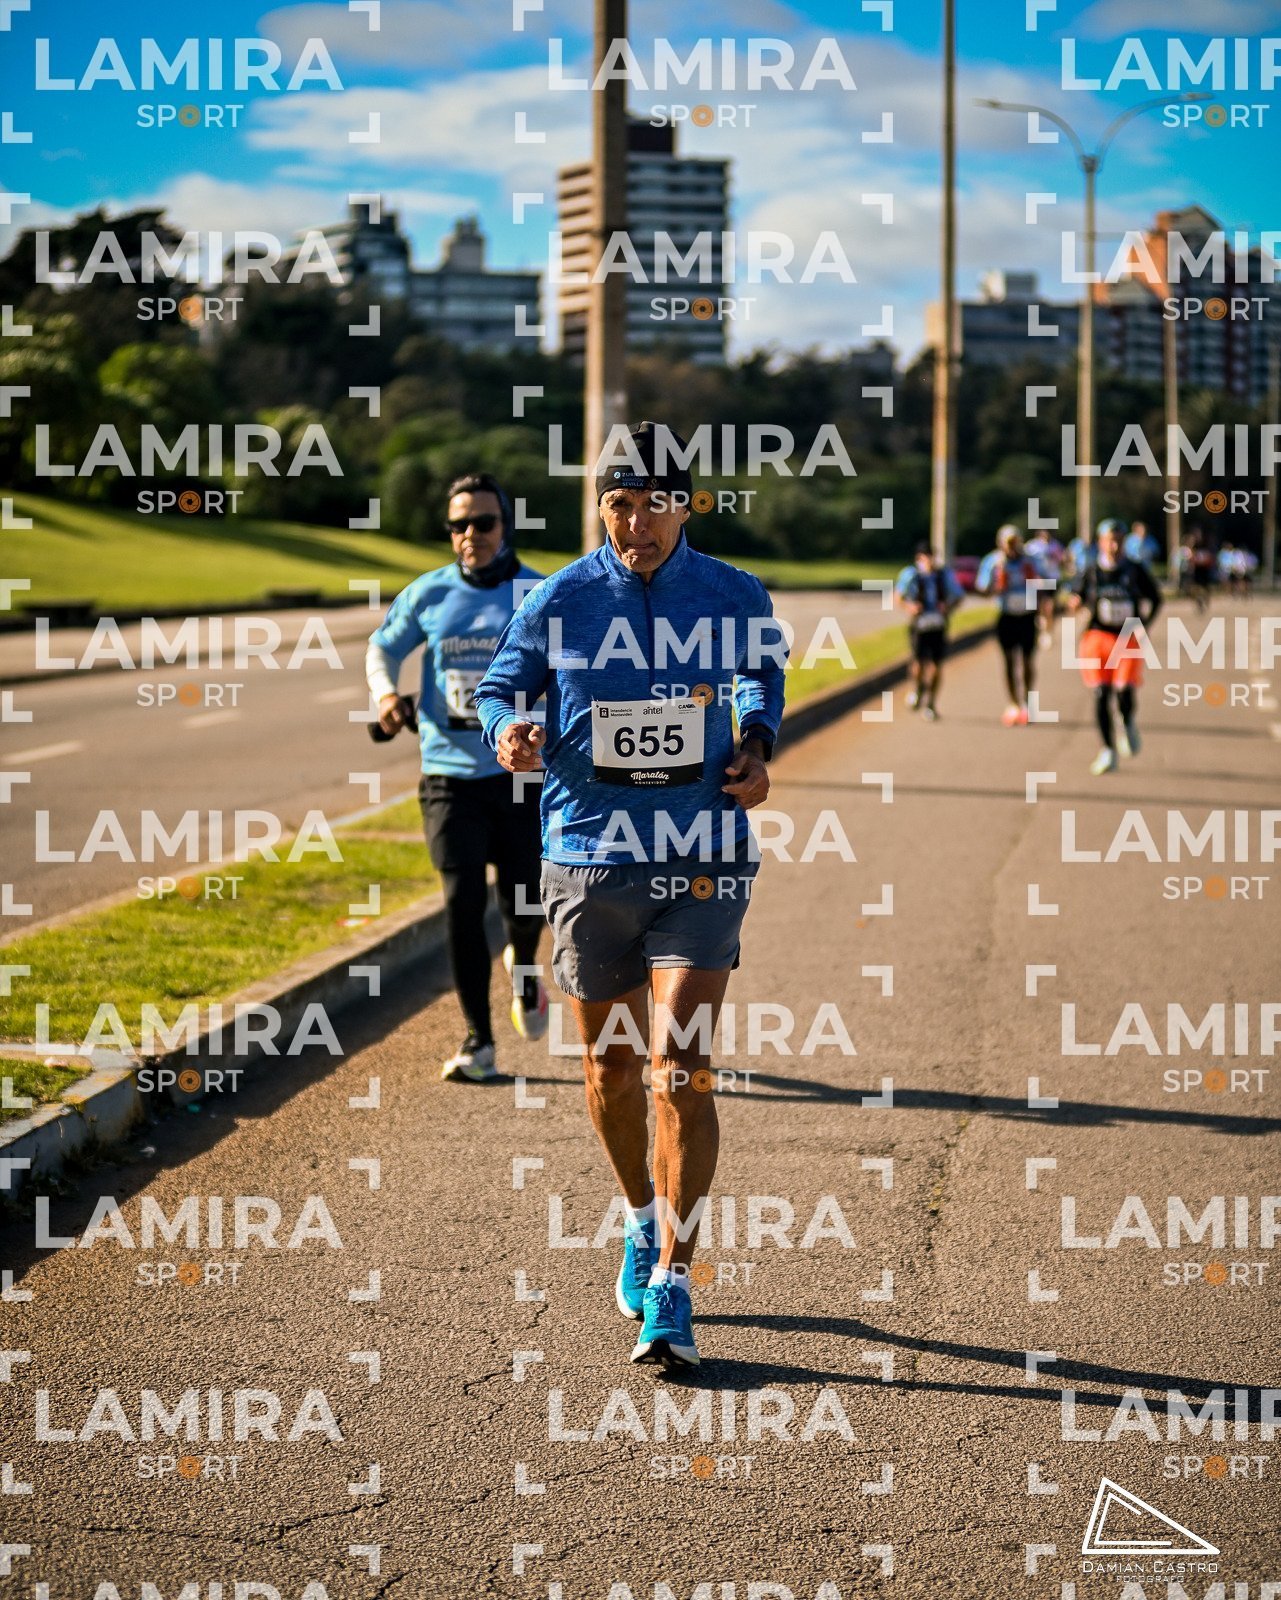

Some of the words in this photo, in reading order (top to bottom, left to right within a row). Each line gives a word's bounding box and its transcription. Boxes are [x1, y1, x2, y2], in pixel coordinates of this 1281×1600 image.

[441, 636, 499, 655] Marat
[452, 687, 477, 710] 12
[643, 706, 663, 716] antel
[613, 724, 684, 758] 655
[630, 771, 670, 781] Maratón
